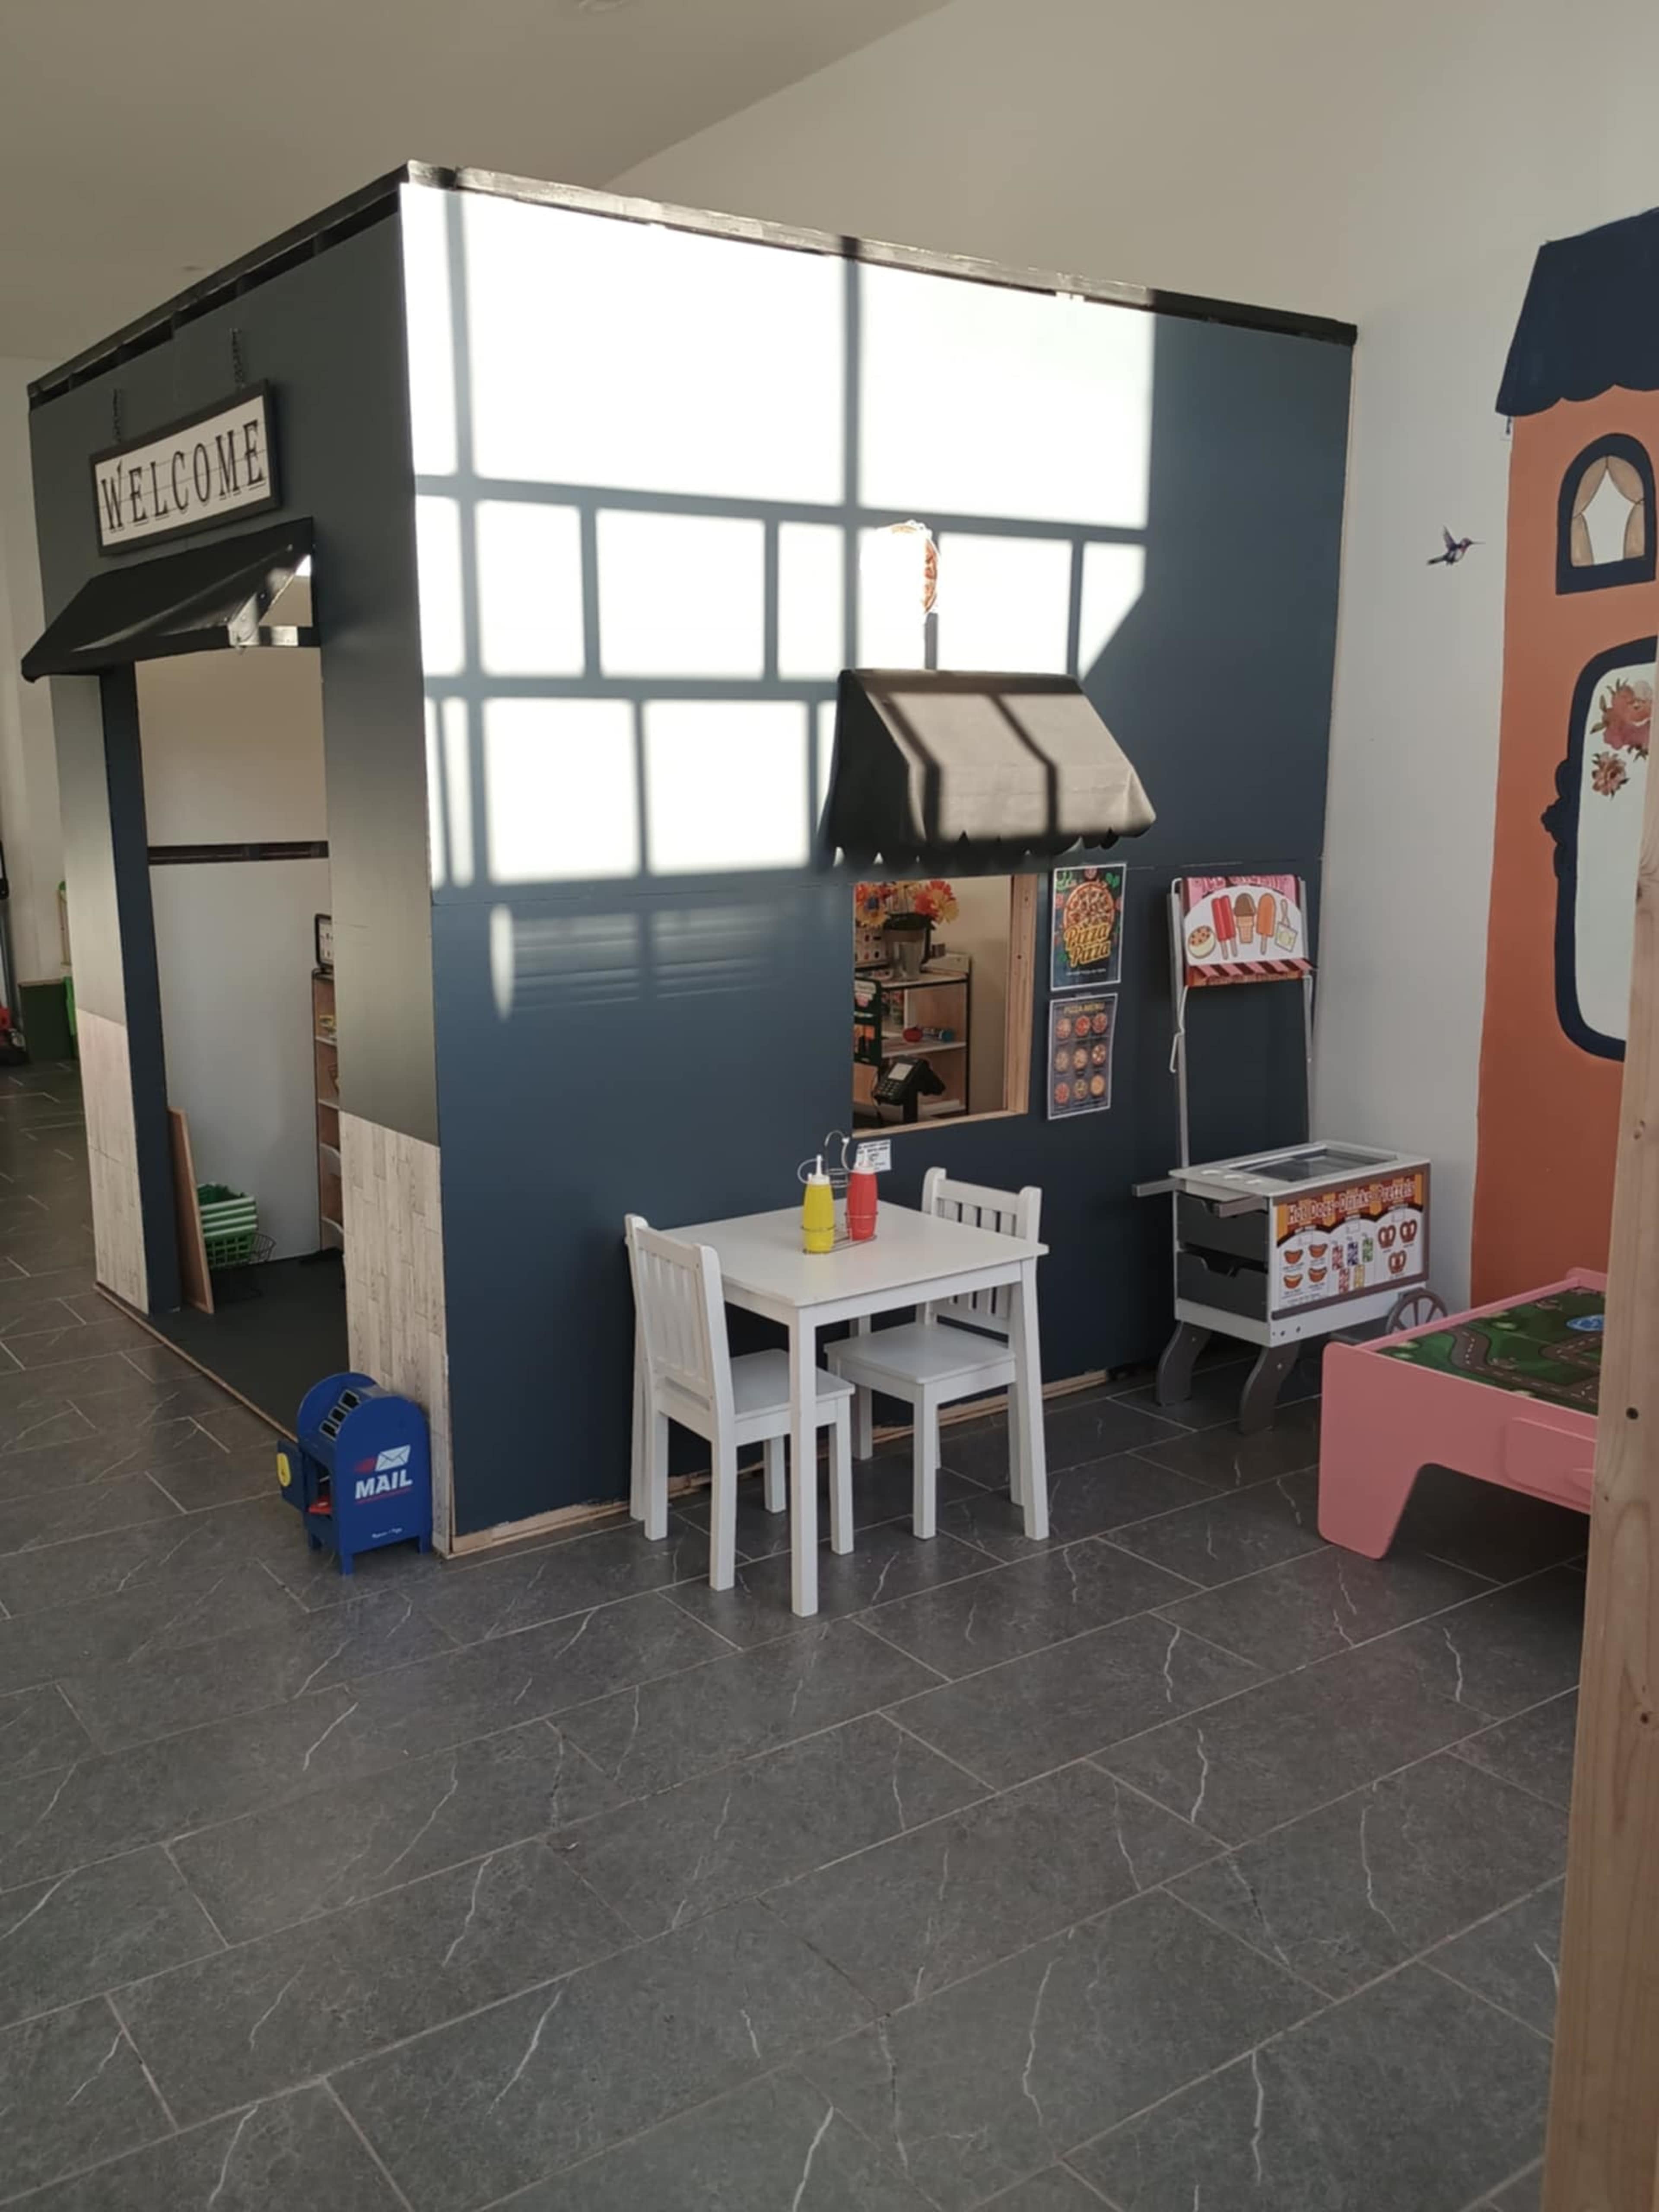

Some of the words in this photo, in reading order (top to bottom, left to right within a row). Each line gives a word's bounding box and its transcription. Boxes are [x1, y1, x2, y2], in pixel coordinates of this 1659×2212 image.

[101, 419, 264, 531] WELCOME
[1065, 924, 1109, 951] Pizza
[1071, 941, 1109, 966] Pizza
[355, 1469, 413, 1500] MAIL
